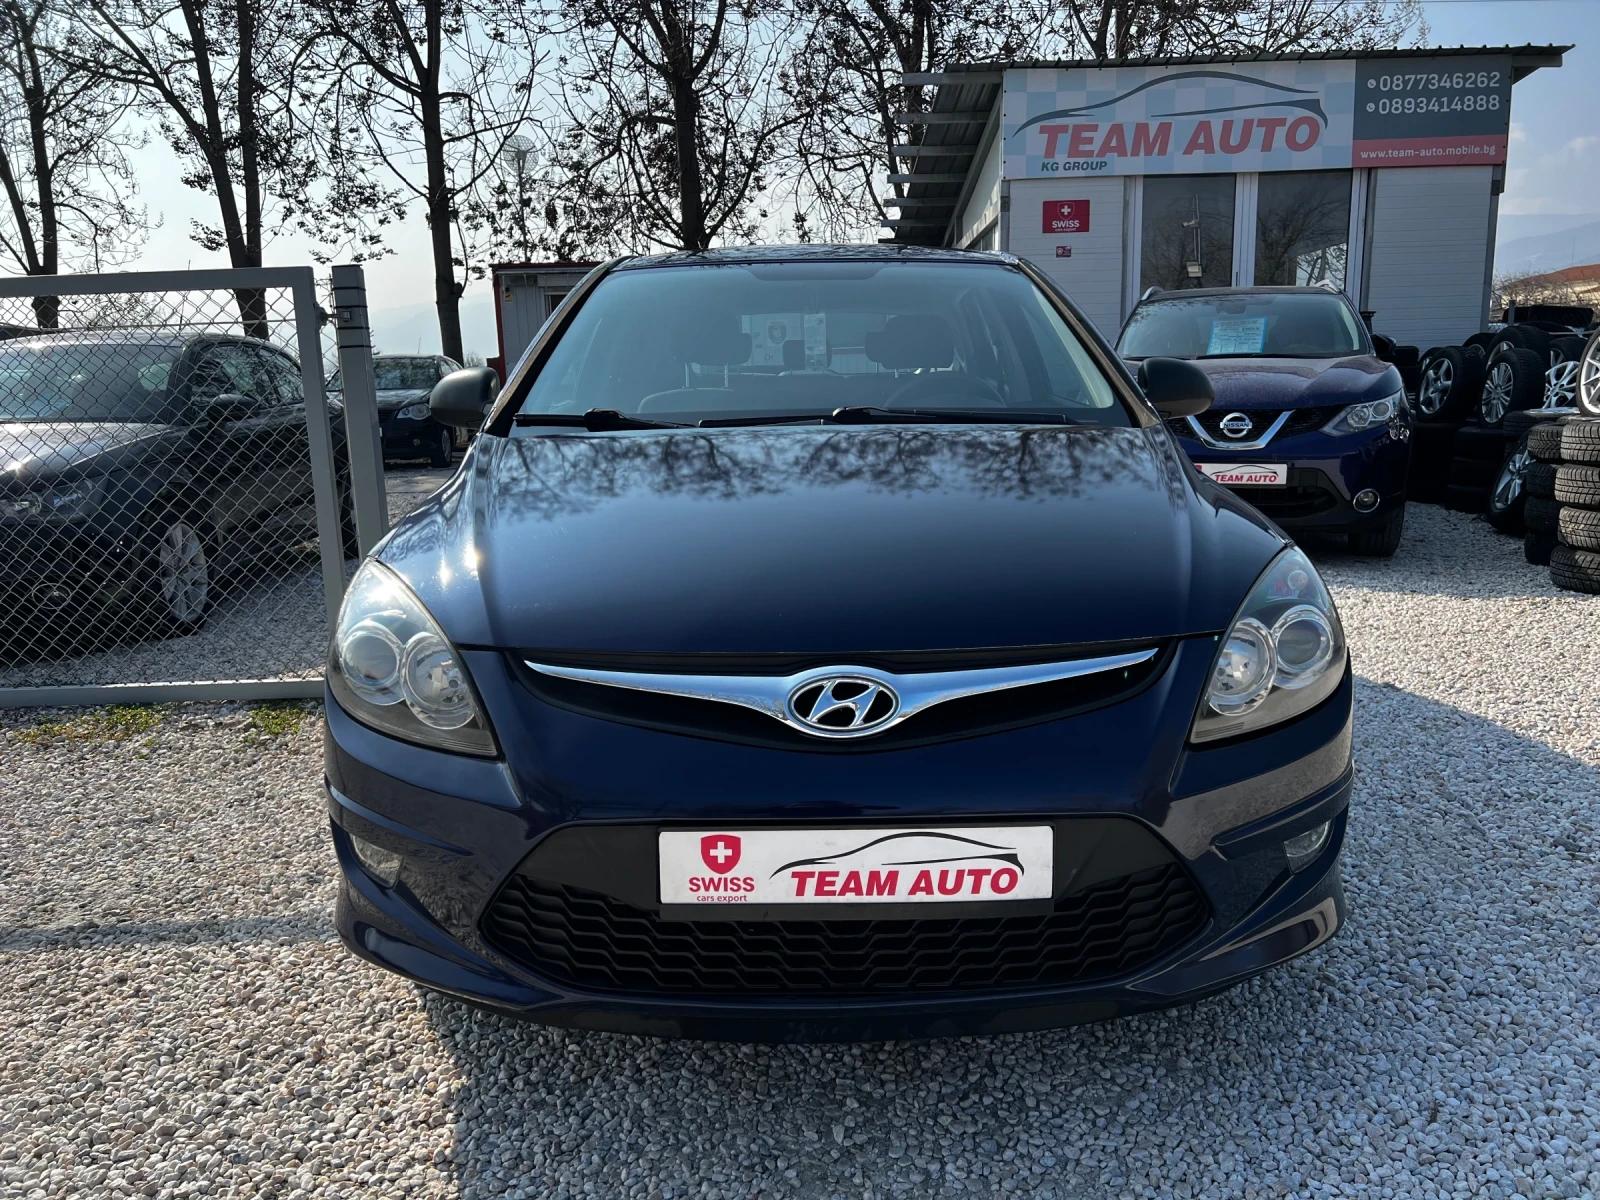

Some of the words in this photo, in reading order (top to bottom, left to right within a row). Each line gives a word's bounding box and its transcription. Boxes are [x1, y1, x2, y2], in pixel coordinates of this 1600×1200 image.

[1379, 71, 1501, 92] 0877346262
[1378, 95, 1501, 115] 0893414888
[1038, 122, 1173, 159] TEAM
[1182, 115, 1321, 156] AUTO
[1360, 145, 1496, 159] www.team-auto.mobile.bg
[1041, 161, 1060, 172] KG
[1062, 160, 1108, 172] GROUP
[1052, 220, 1080, 228] SWISS
[1214, 474, 1244, 483] TEAM
[1246, 474, 1277, 483] AUTO
[688, 876, 756, 893] SWISS
[790, 869, 900, 897] TEAM
[907, 867, 1020, 896] AUTO
[696, 894, 715, 902] cars
[716, 894, 748, 904] export
